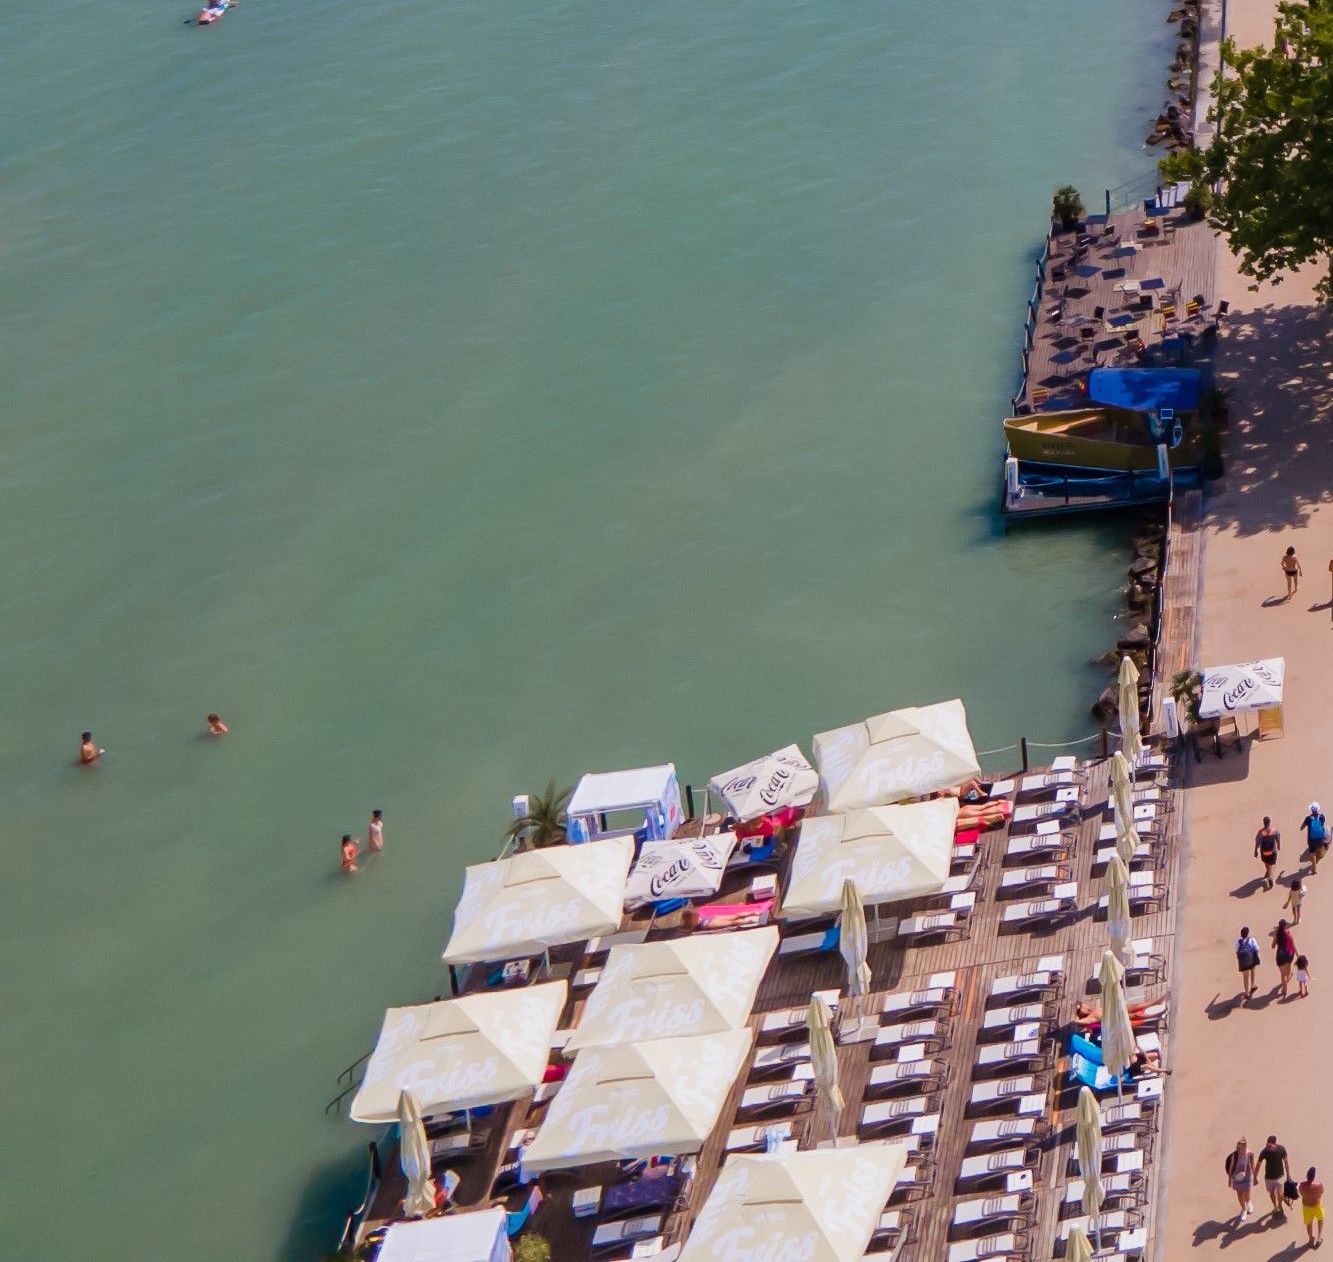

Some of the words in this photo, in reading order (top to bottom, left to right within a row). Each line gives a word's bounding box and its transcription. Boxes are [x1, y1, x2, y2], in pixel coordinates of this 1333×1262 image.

[483, 897, 581, 951] Friss
[607, 998, 705, 1046] Friss
[394, 1055, 498, 1106] Friss
[567, 1104, 671, 1158] Friss
